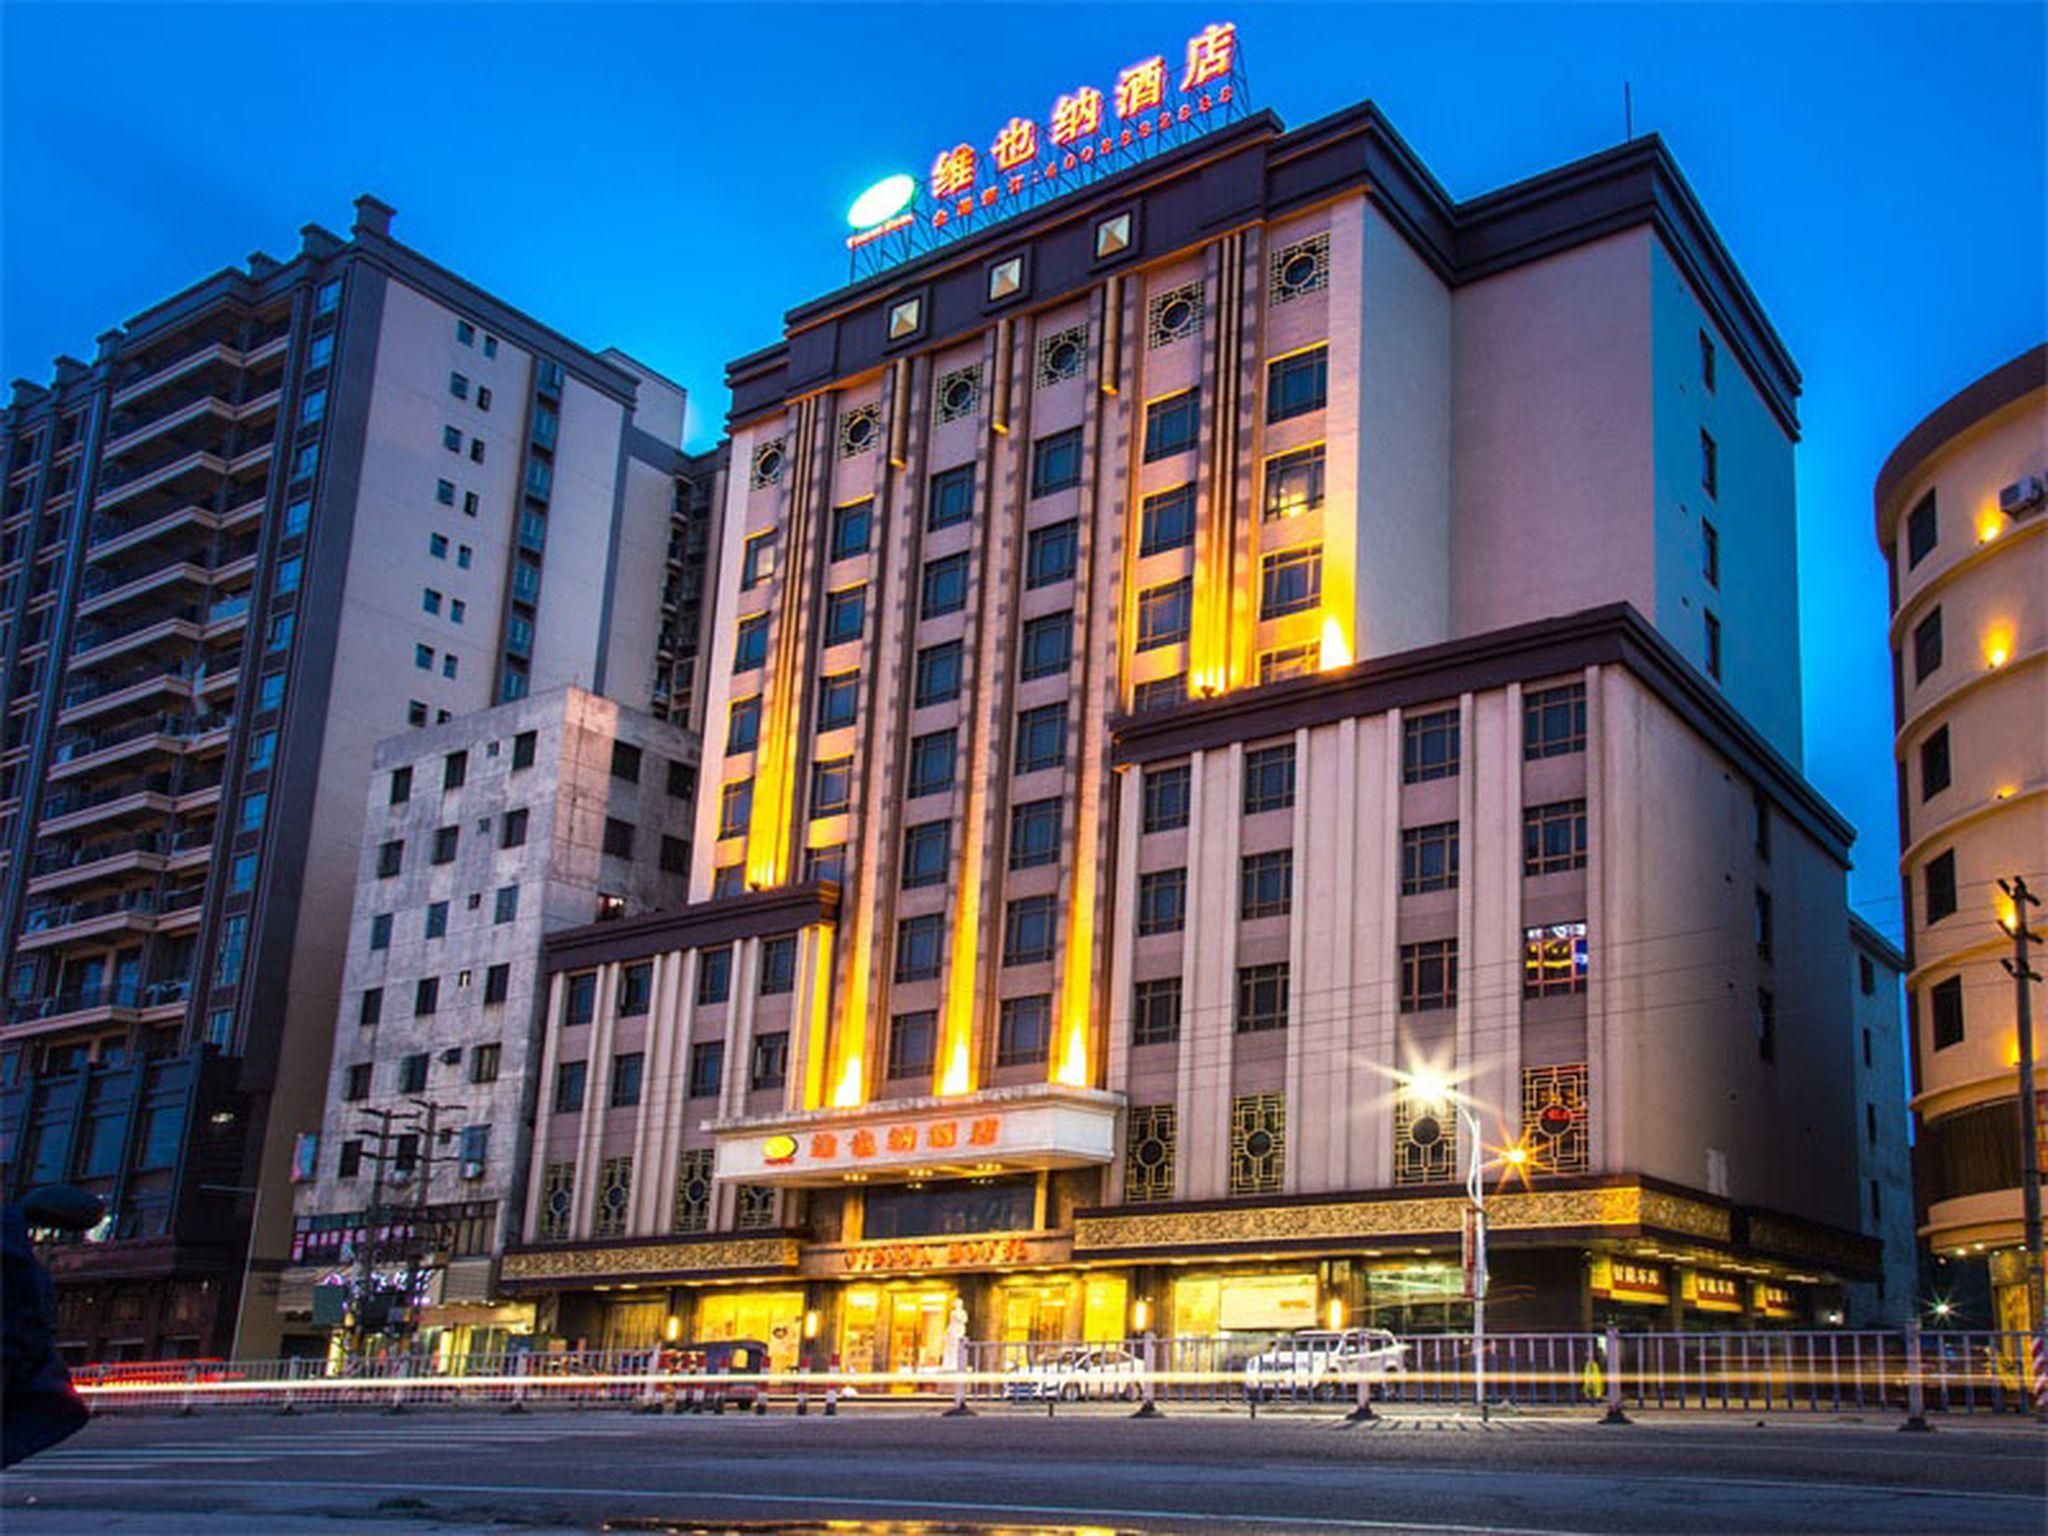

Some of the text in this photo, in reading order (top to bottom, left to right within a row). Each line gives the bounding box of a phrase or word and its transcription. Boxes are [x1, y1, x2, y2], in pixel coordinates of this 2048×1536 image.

[931, 22, 1236, 200] 维也纳酒店
